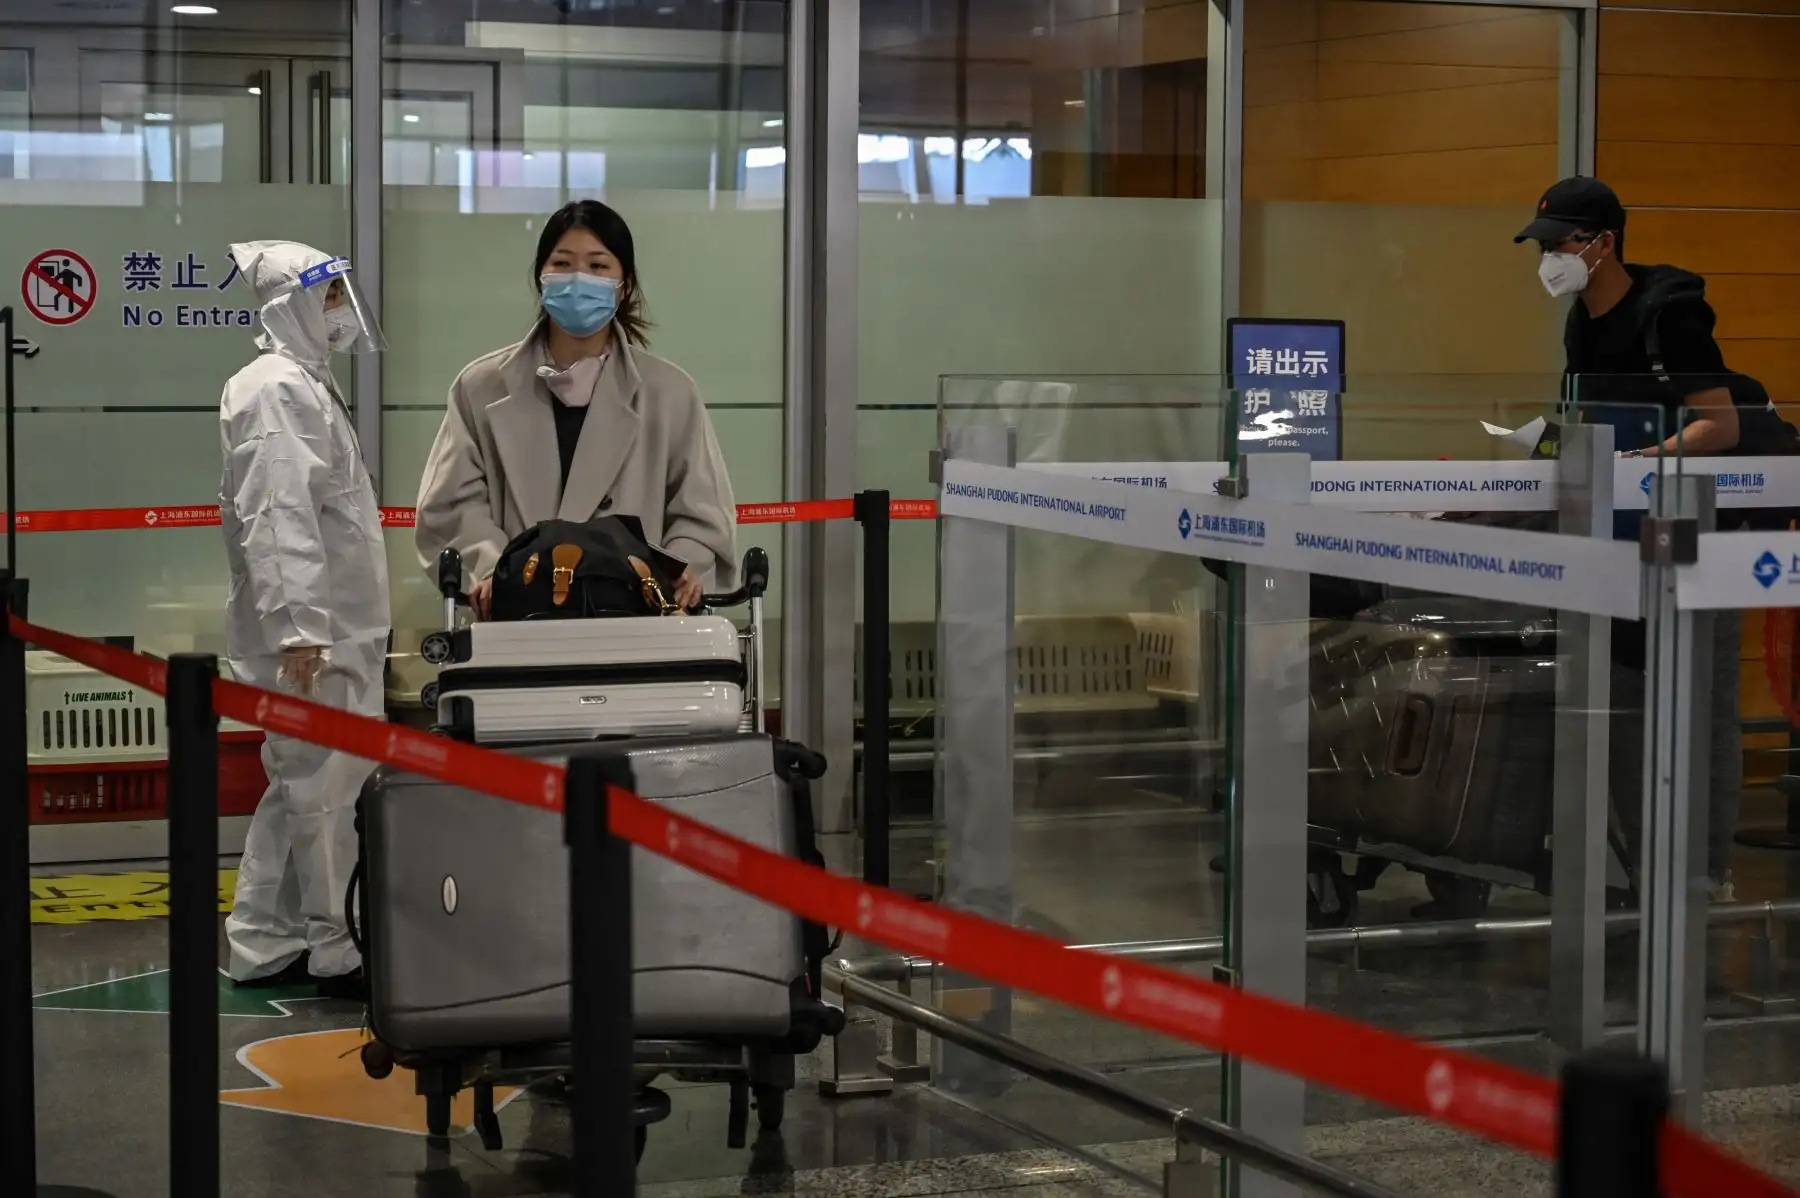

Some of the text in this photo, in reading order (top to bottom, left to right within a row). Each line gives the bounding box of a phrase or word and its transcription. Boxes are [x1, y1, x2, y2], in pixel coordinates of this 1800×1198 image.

[123, 305, 259, 326] No Entra
[1246, 348, 1329, 375] 请出示
[1267, 437, 1301, 448] please.
[1359, 480, 1477, 493] INTERNATIONAL
[1481, 479, 1542, 492] AIRPORT
[1716, 473, 1765, 487] 国际机场
[946, 482, 1127, 521] SHANGHAI PUDONG INTERNATIONAL AIRPORT
[1295, 532, 1566, 582] SHANGHAI PUDONG INTERNATIONAL AIRPORT
[71, 690, 127, 702] LIVE ANIMALS
